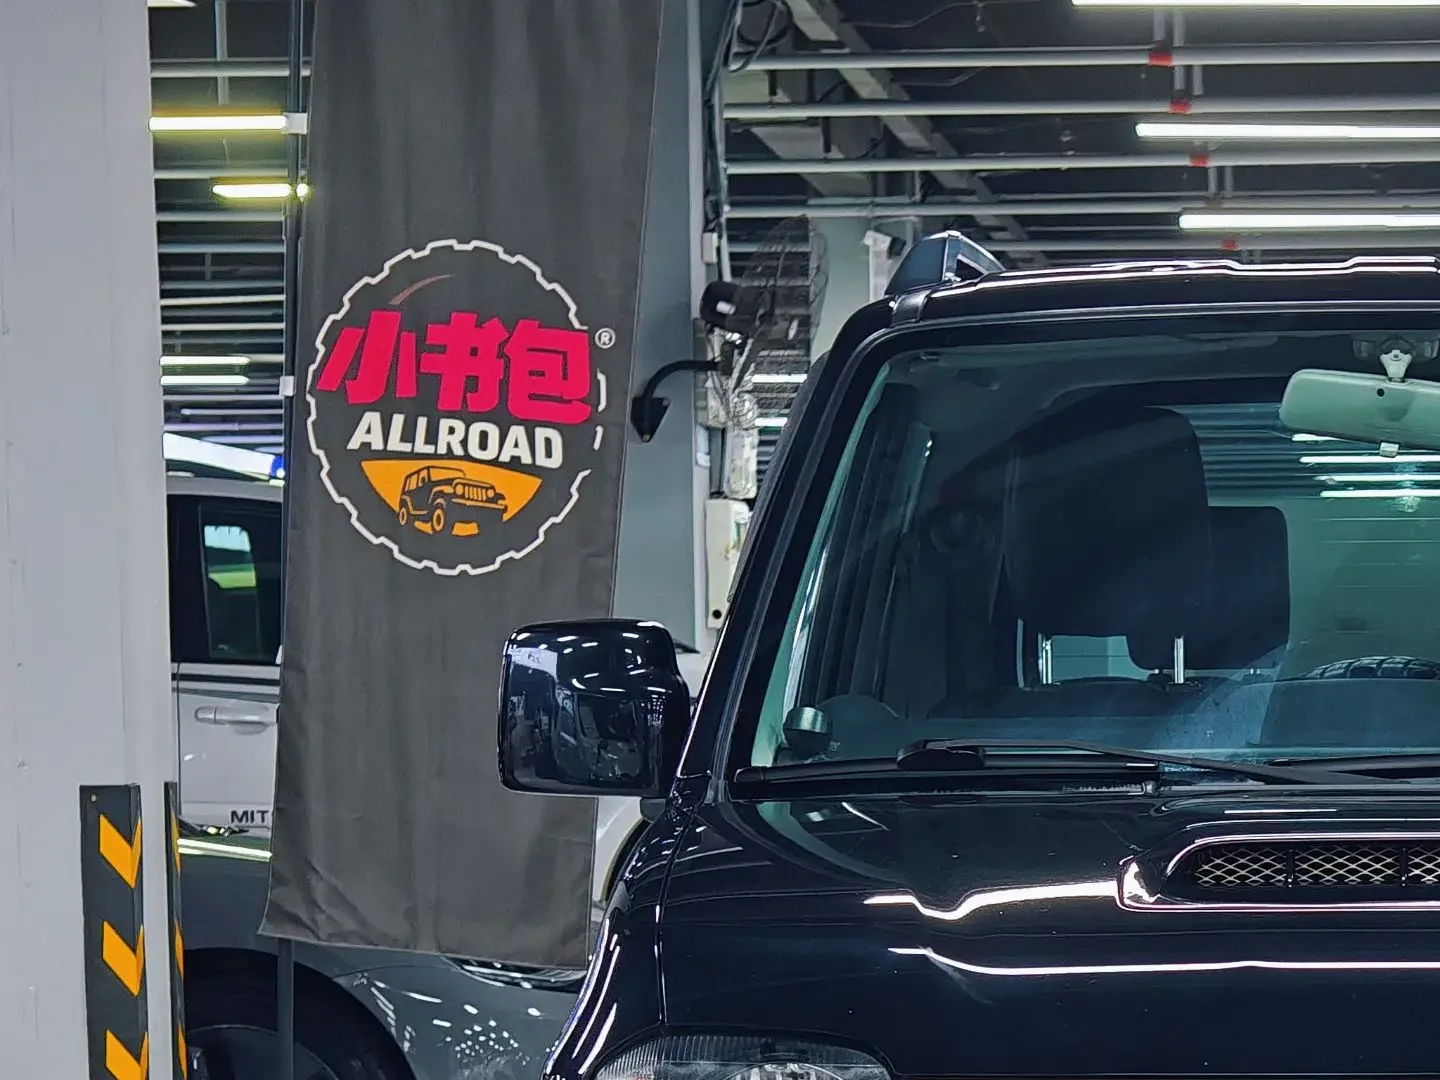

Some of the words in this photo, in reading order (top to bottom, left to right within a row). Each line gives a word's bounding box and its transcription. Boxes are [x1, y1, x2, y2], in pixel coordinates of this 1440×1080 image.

[316, 309, 592, 424] 小书包
[346, 411, 564, 470] ALLROAD
